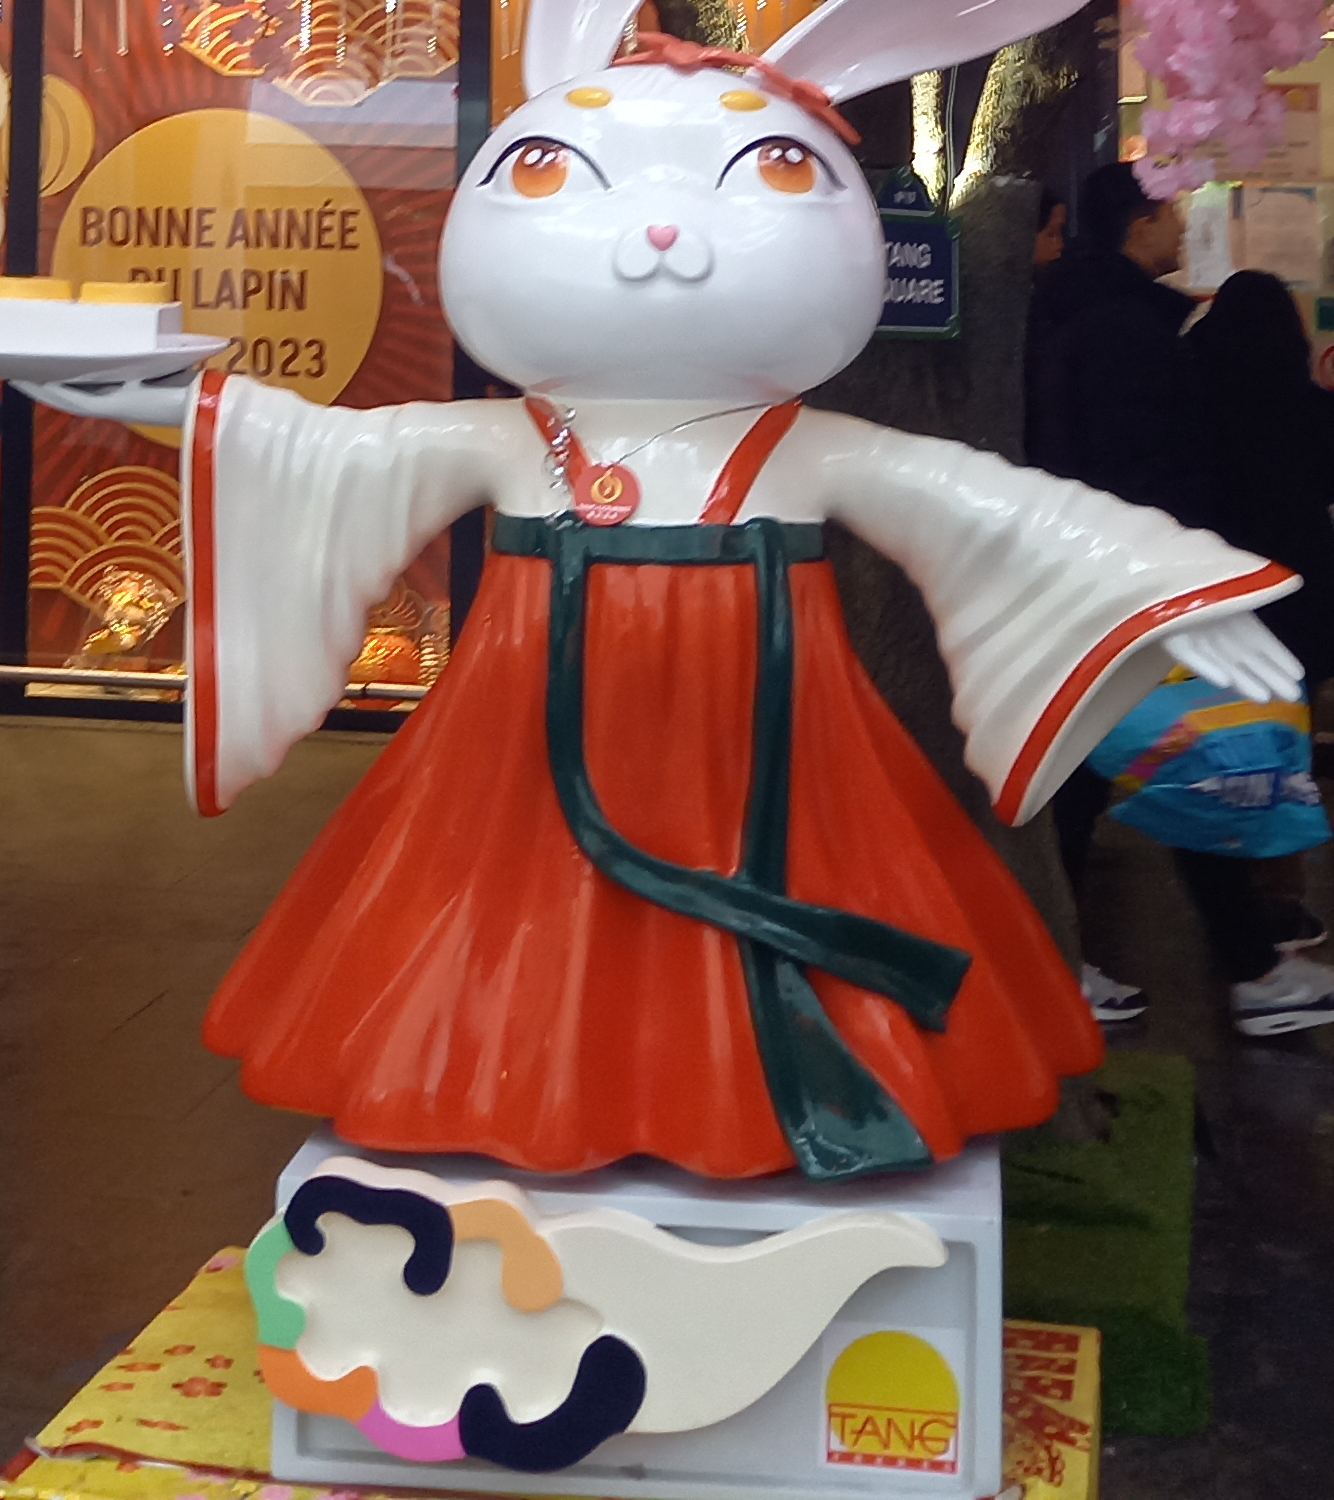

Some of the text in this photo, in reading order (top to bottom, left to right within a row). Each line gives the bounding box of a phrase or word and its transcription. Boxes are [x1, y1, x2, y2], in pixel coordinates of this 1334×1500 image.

[80, 198, 361, 250] BONNE ANNÉE
[191, 267, 309, 311] LAPIN
[227, 335, 327, 379] 2023
[830, 1411, 956, 1456] TANG
